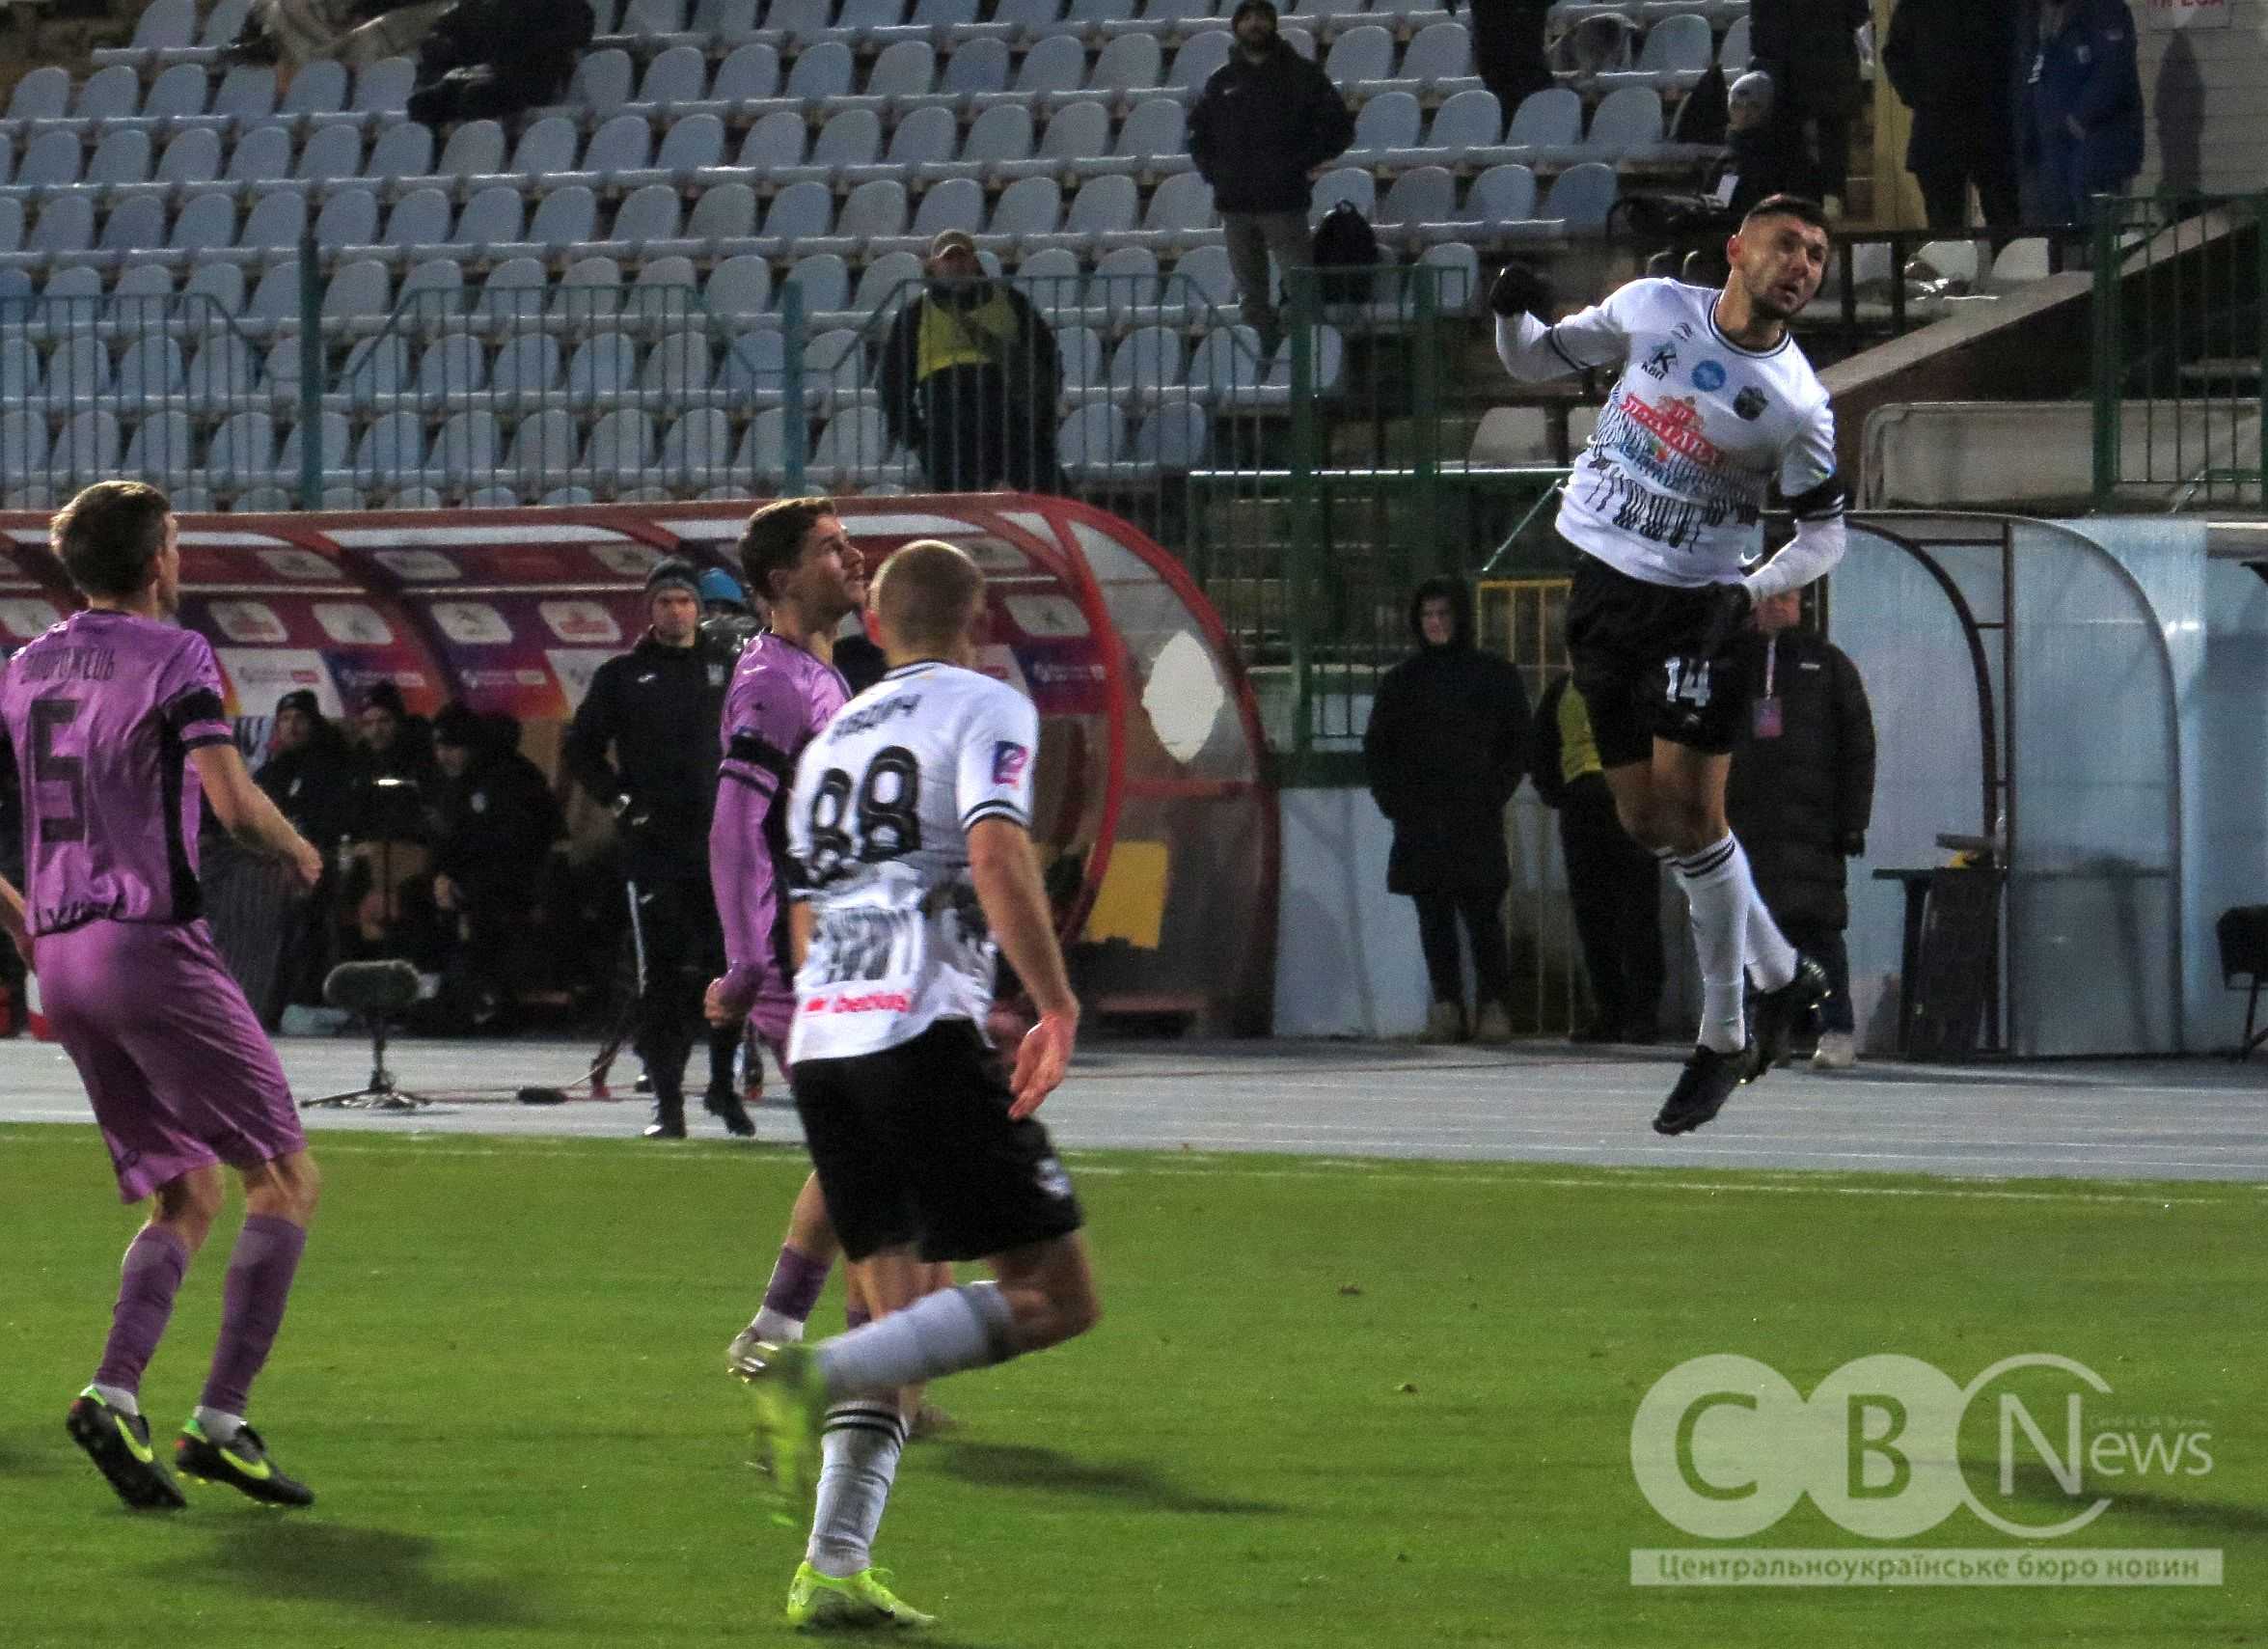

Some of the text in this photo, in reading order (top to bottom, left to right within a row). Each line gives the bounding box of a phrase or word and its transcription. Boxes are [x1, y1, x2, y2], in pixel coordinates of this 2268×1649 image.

[1664, 655, 1712, 707] 14
[30, 699, 85, 844] 5
[806, 744, 922, 880] 88
